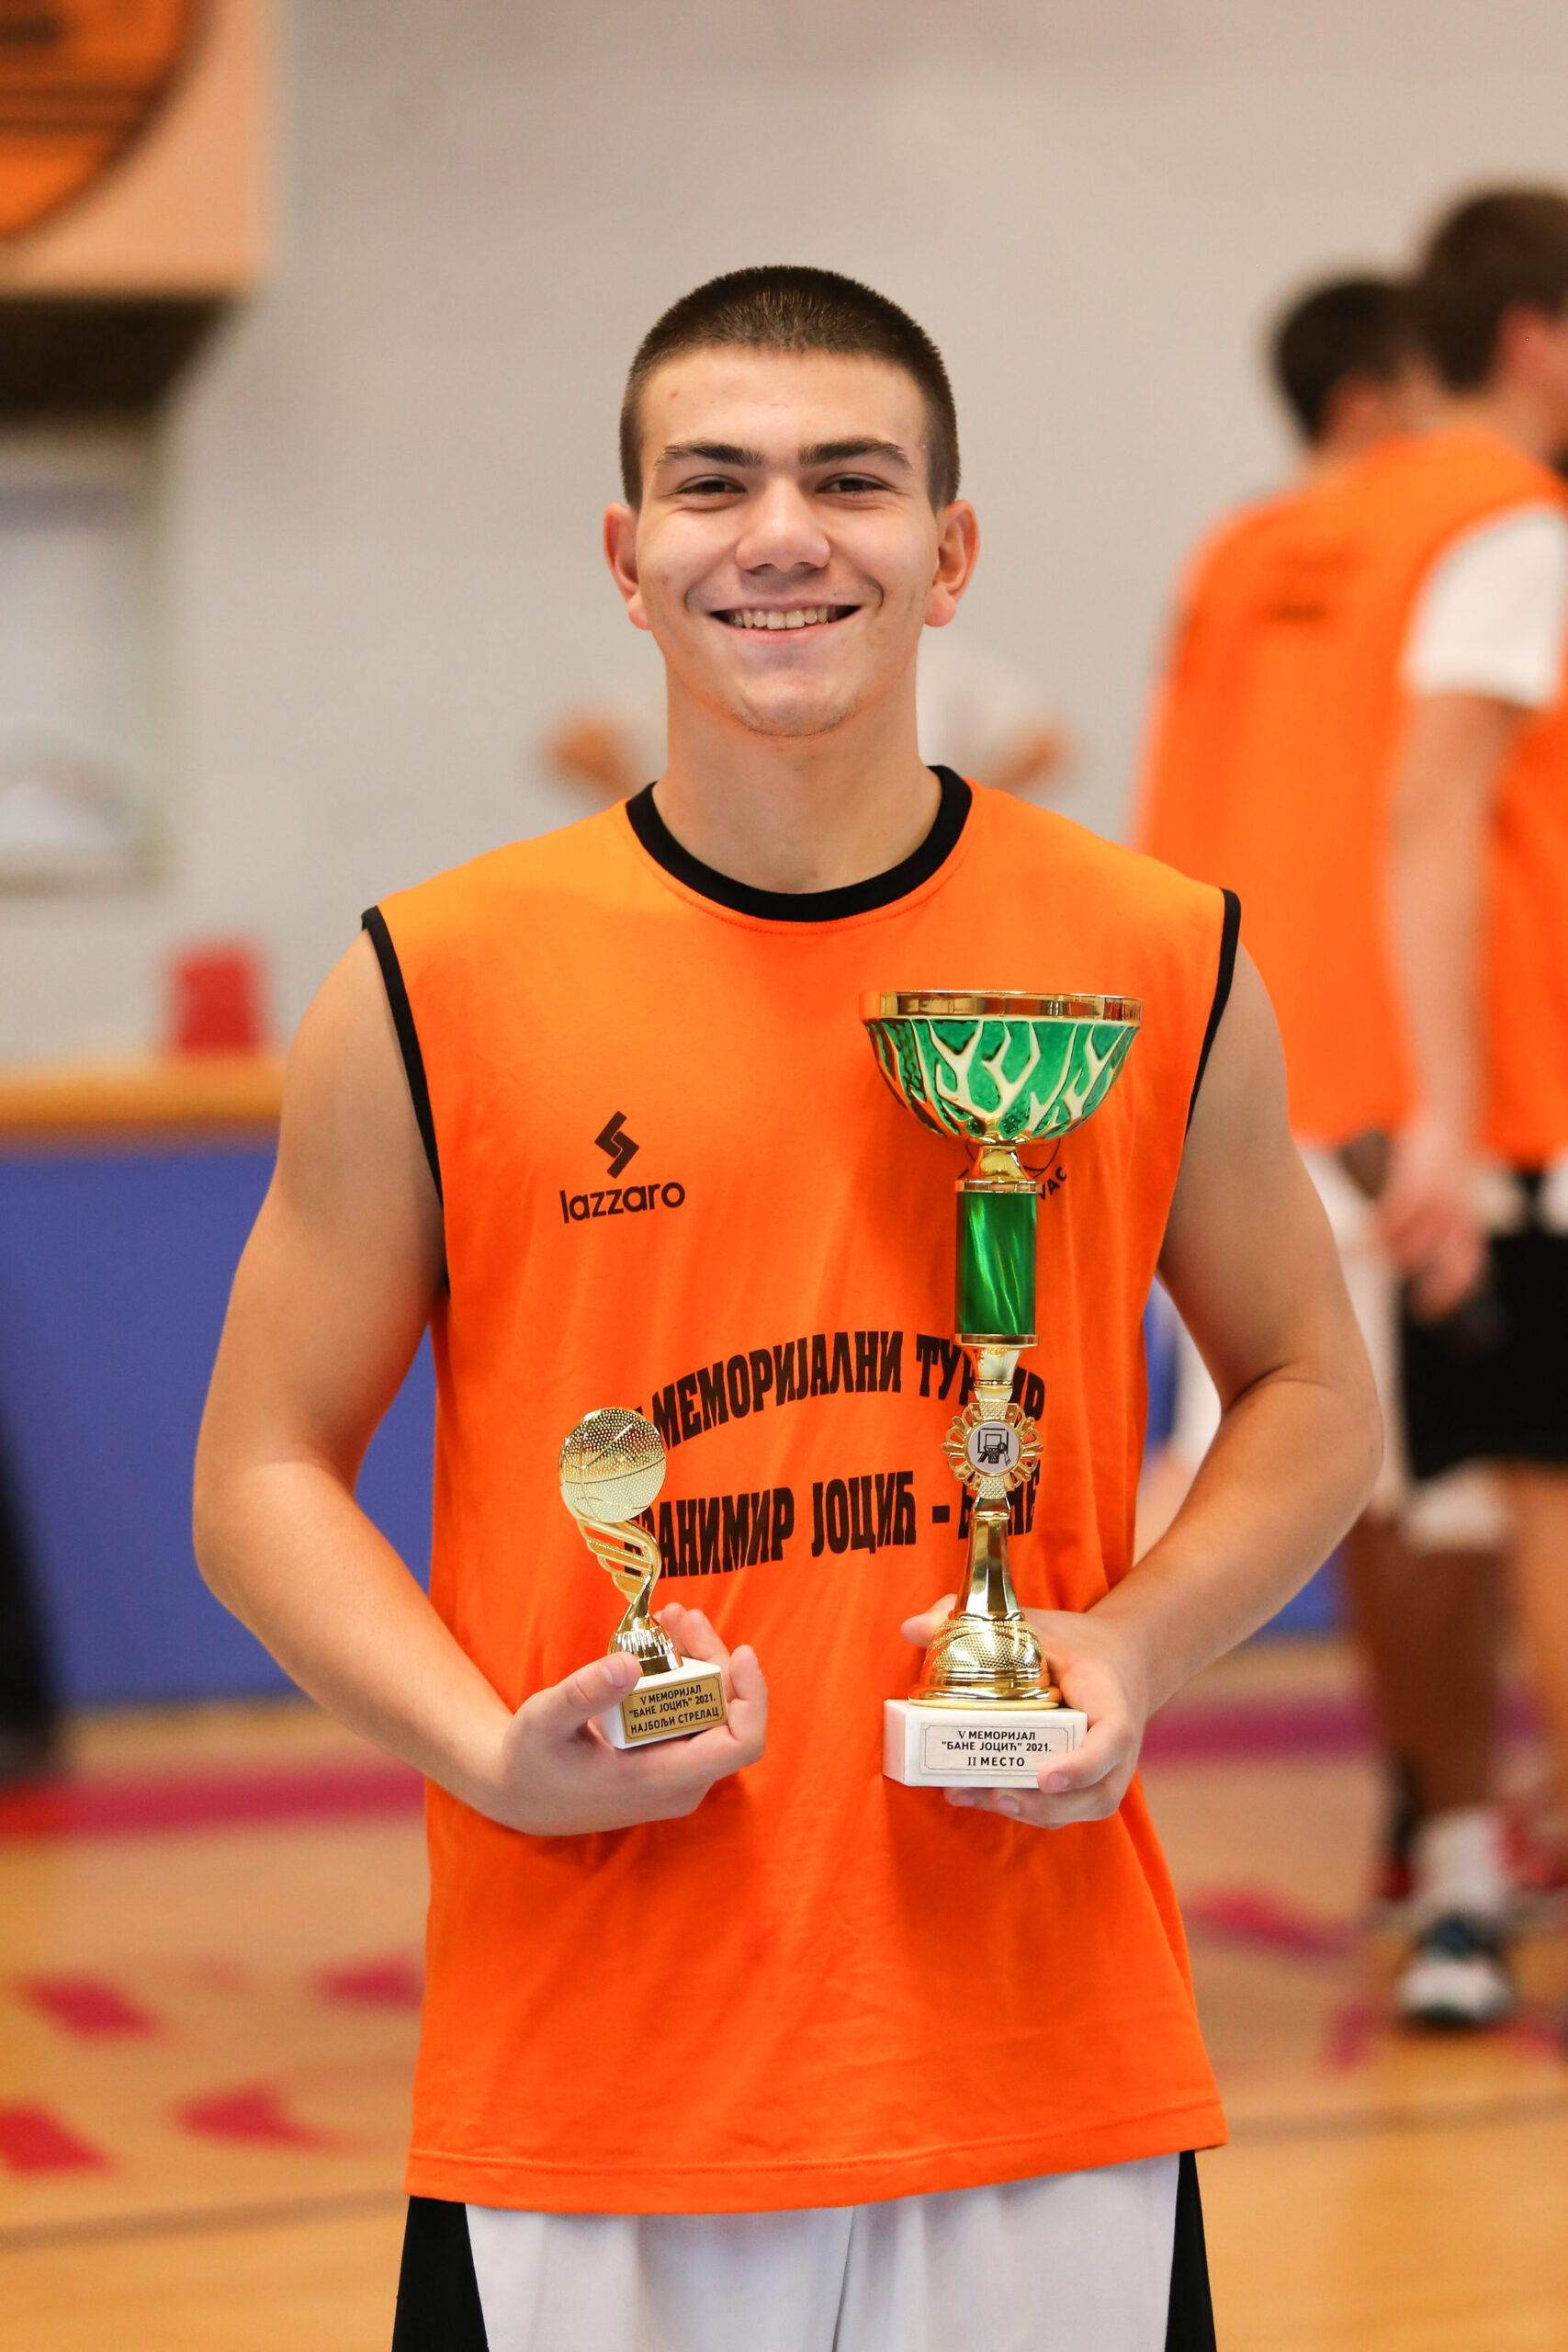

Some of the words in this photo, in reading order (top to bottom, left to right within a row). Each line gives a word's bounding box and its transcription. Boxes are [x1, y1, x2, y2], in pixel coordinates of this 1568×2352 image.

[559, 1182, 685, 1224] lazzaro
[651, 1330, 904, 1451] МЕМОРИЈАЛНИ
[624, 1487, 795, 1579] АНИМИР
[811, 1470, 917, 1557] ЈОЦИЋ
[629, 1705, 657, 1718] "БАНЕ
[695, 1693, 716, 1705] 2021.
[640, 1696, 648, 1705] V
[649, 1685, 701, 1703] МЕМОРИЈАЛ
[631, 1716, 675, 1734] НАЈБОЉИ
[678, 1707, 719, 1723] СТРЕЛАЦ
[942, 1741, 976, 1751] "БАНЕ
[1025, 1743, 1052, 1752] 2021.
[958, 1730, 966, 1739] V
[968, 1730, 1036, 1740] МЕМОРИЈАЛ
[980, 1757, 1025, 1767] МЕСТО
